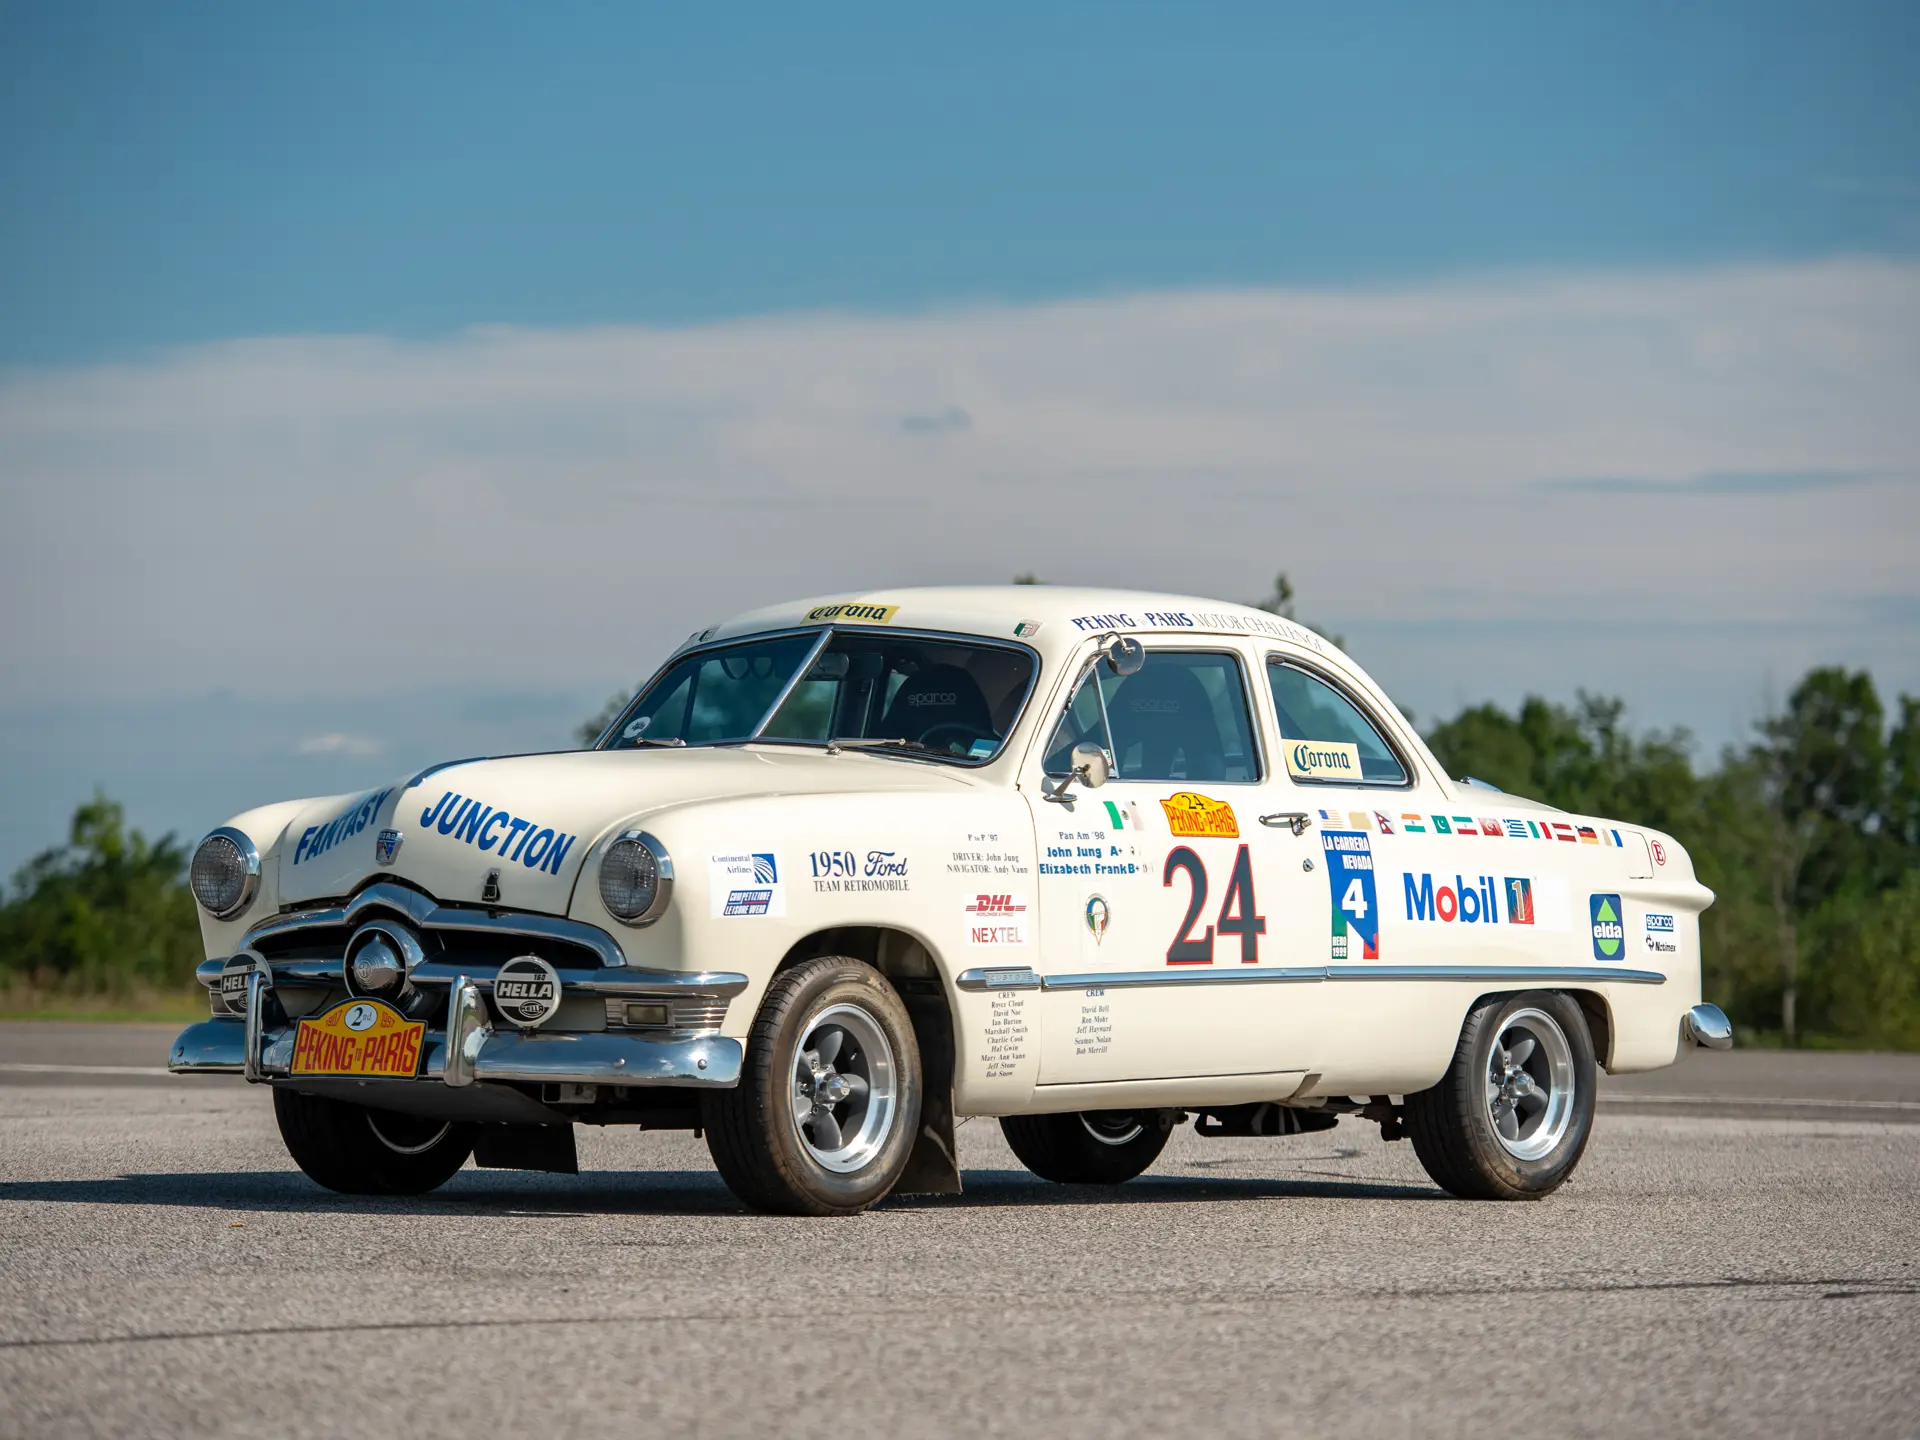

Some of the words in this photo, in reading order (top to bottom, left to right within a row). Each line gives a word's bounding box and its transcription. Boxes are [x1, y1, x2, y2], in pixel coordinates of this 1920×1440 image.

[809, 605, 888, 620] Corona
[1071, 613, 1137, 630] PEKING
[1144, 612, 1194, 627] PARIS
[1191, 613, 1245, 629] MOTOR
[1243, 616, 1322, 652] CHALLENGE
[908, 692, 956, 706] sparco
[1294, 744, 1351, 771] Corona
[1181, 795, 1206, 810] 24
[293, 786, 396, 865] FANTASY
[1164, 803, 1204, 832] PEKING
[1205, 805, 1236, 833] PARIS
[420, 791, 576, 876] JUNCTION
[1059, 831, 1074, 840] Pan
[1077, 831, 1090, 840] Am
[1323, 836, 1335, 850] LA
[1334, 836, 1370, 851] CARRERA
[712, 854, 751, 863] Continental
[952, 853, 984, 861] DRIVER:
[986, 853, 1001, 861] John
[1003, 853, 1019, 862] Jung
[1047, 847, 1073, 857] John
[1076, 847, 1102, 859] Jung
[1653, 844, 1664, 861] E
[809, 851, 856, 877] 1950
[864, 850, 908, 876] Ford
[946, 865, 992, 873] NAVIGATOR:
[994, 865, 1009, 874] Andy
[1039, 863, 1092, 874] Elizabeth
[1095, 863, 1127, 874] Frank
[1342, 855, 1372, 869] NEVADA
[726, 866, 752, 874] Airlines
[813, 880, 841, 892] TEAM
[844, 879, 910, 892] RETROMOBILE
[729, 891, 771, 902] COMPETIZIONE
[976, 895, 1015, 911] DHL
[1341, 878, 1368, 919] 4
[1403, 872, 1498, 923] Mobil
[1511, 879, 1525, 921] 1
[724, 905, 749, 915] LEISURE
[749, 904, 767, 914] WEAR
[1163, 844, 1267, 966] 24
[1646, 915, 1673, 927] sparco
[972, 927, 1023, 943] NEXTEL
[1593, 922, 1622, 939] elda
[1332, 936, 1347, 946] RENO
[498, 983, 552, 997] HELLA
[293, 1022, 356, 1071] PEKING
[360, 1025, 421, 1073] PARIS
